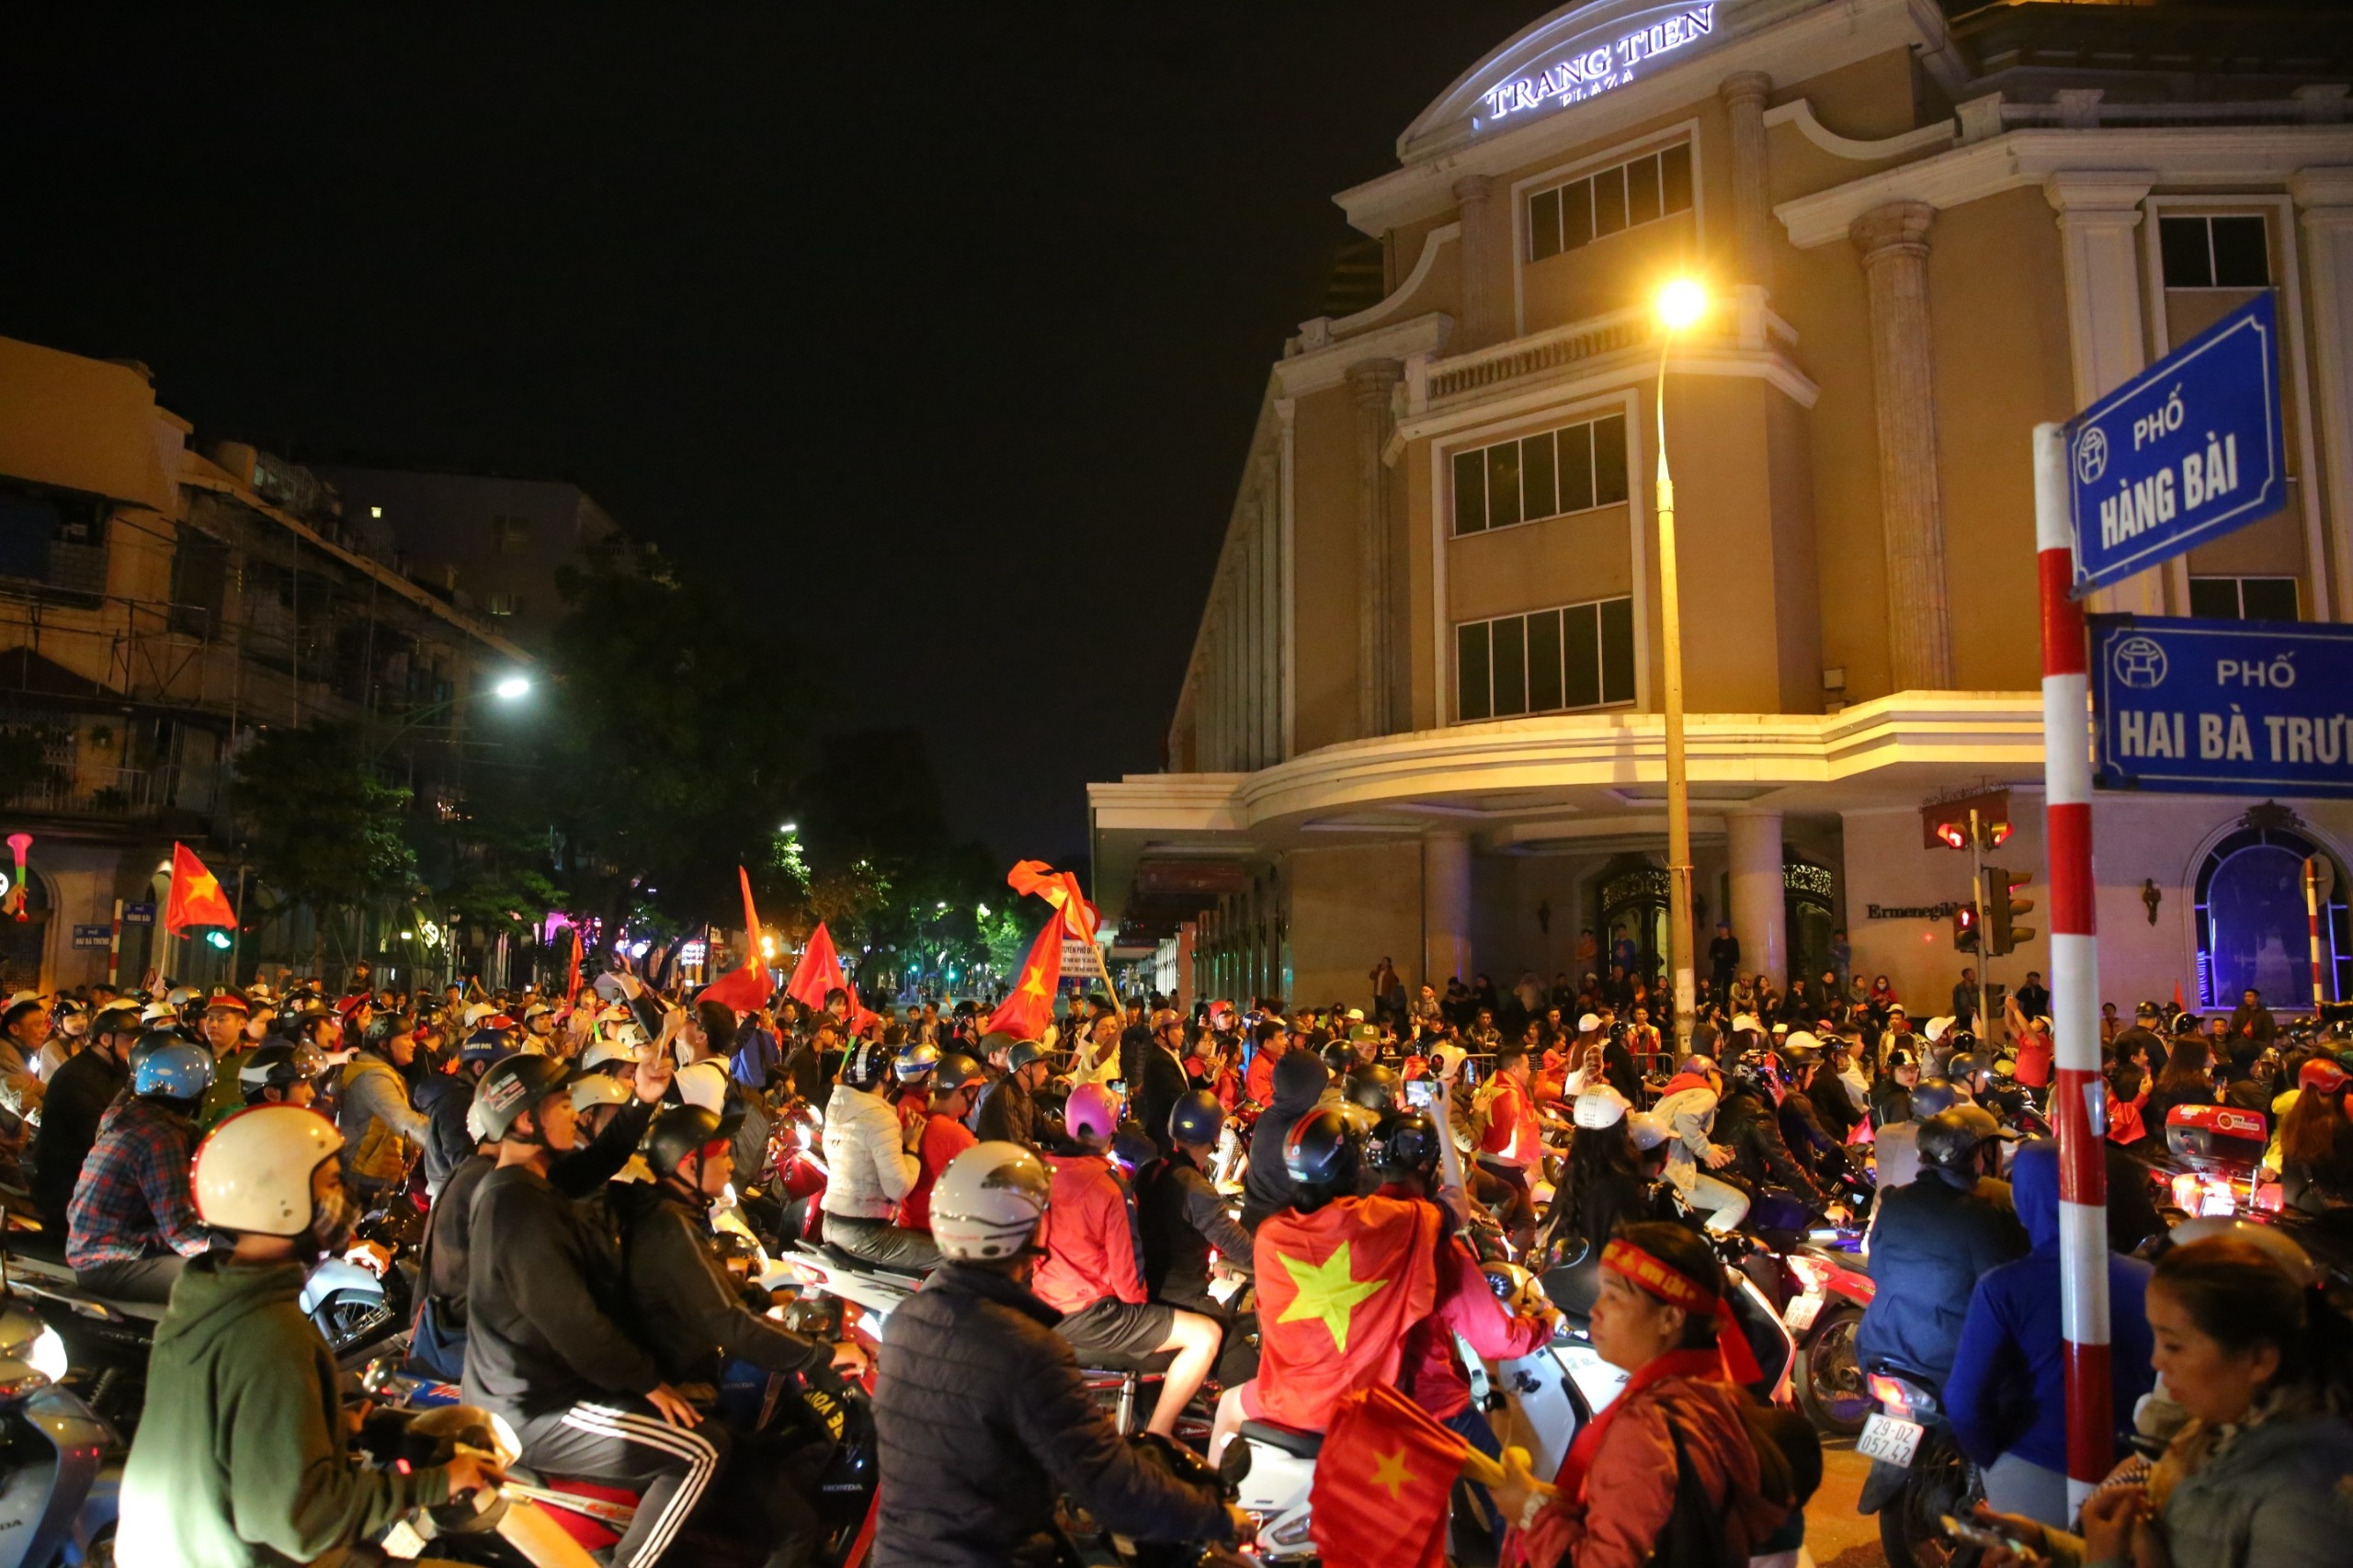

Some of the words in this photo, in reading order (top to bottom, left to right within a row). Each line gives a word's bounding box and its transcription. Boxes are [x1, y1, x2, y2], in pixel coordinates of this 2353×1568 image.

[1485, 44, 1611, 119] TRANG
[1617, 3, 1714, 67] TIEN
[1560, 70, 1634, 107] PLAZA
[2133, 382, 2184, 451] PHỐ
[2100, 478, 2176, 551] HÀNG
[2182, 430, 2238, 511] BÀI
[2217, 651, 2296, 688] PHỐ
[2120, 710, 2186, 758] HAI
[2199, 703, 2254, 761] BÀ
[1860, 1435, 1911, 1464] 057.42
[1872, 1419, 1914, 1444] 29-D2
[823, 1483, 864, 1492] HONDA
